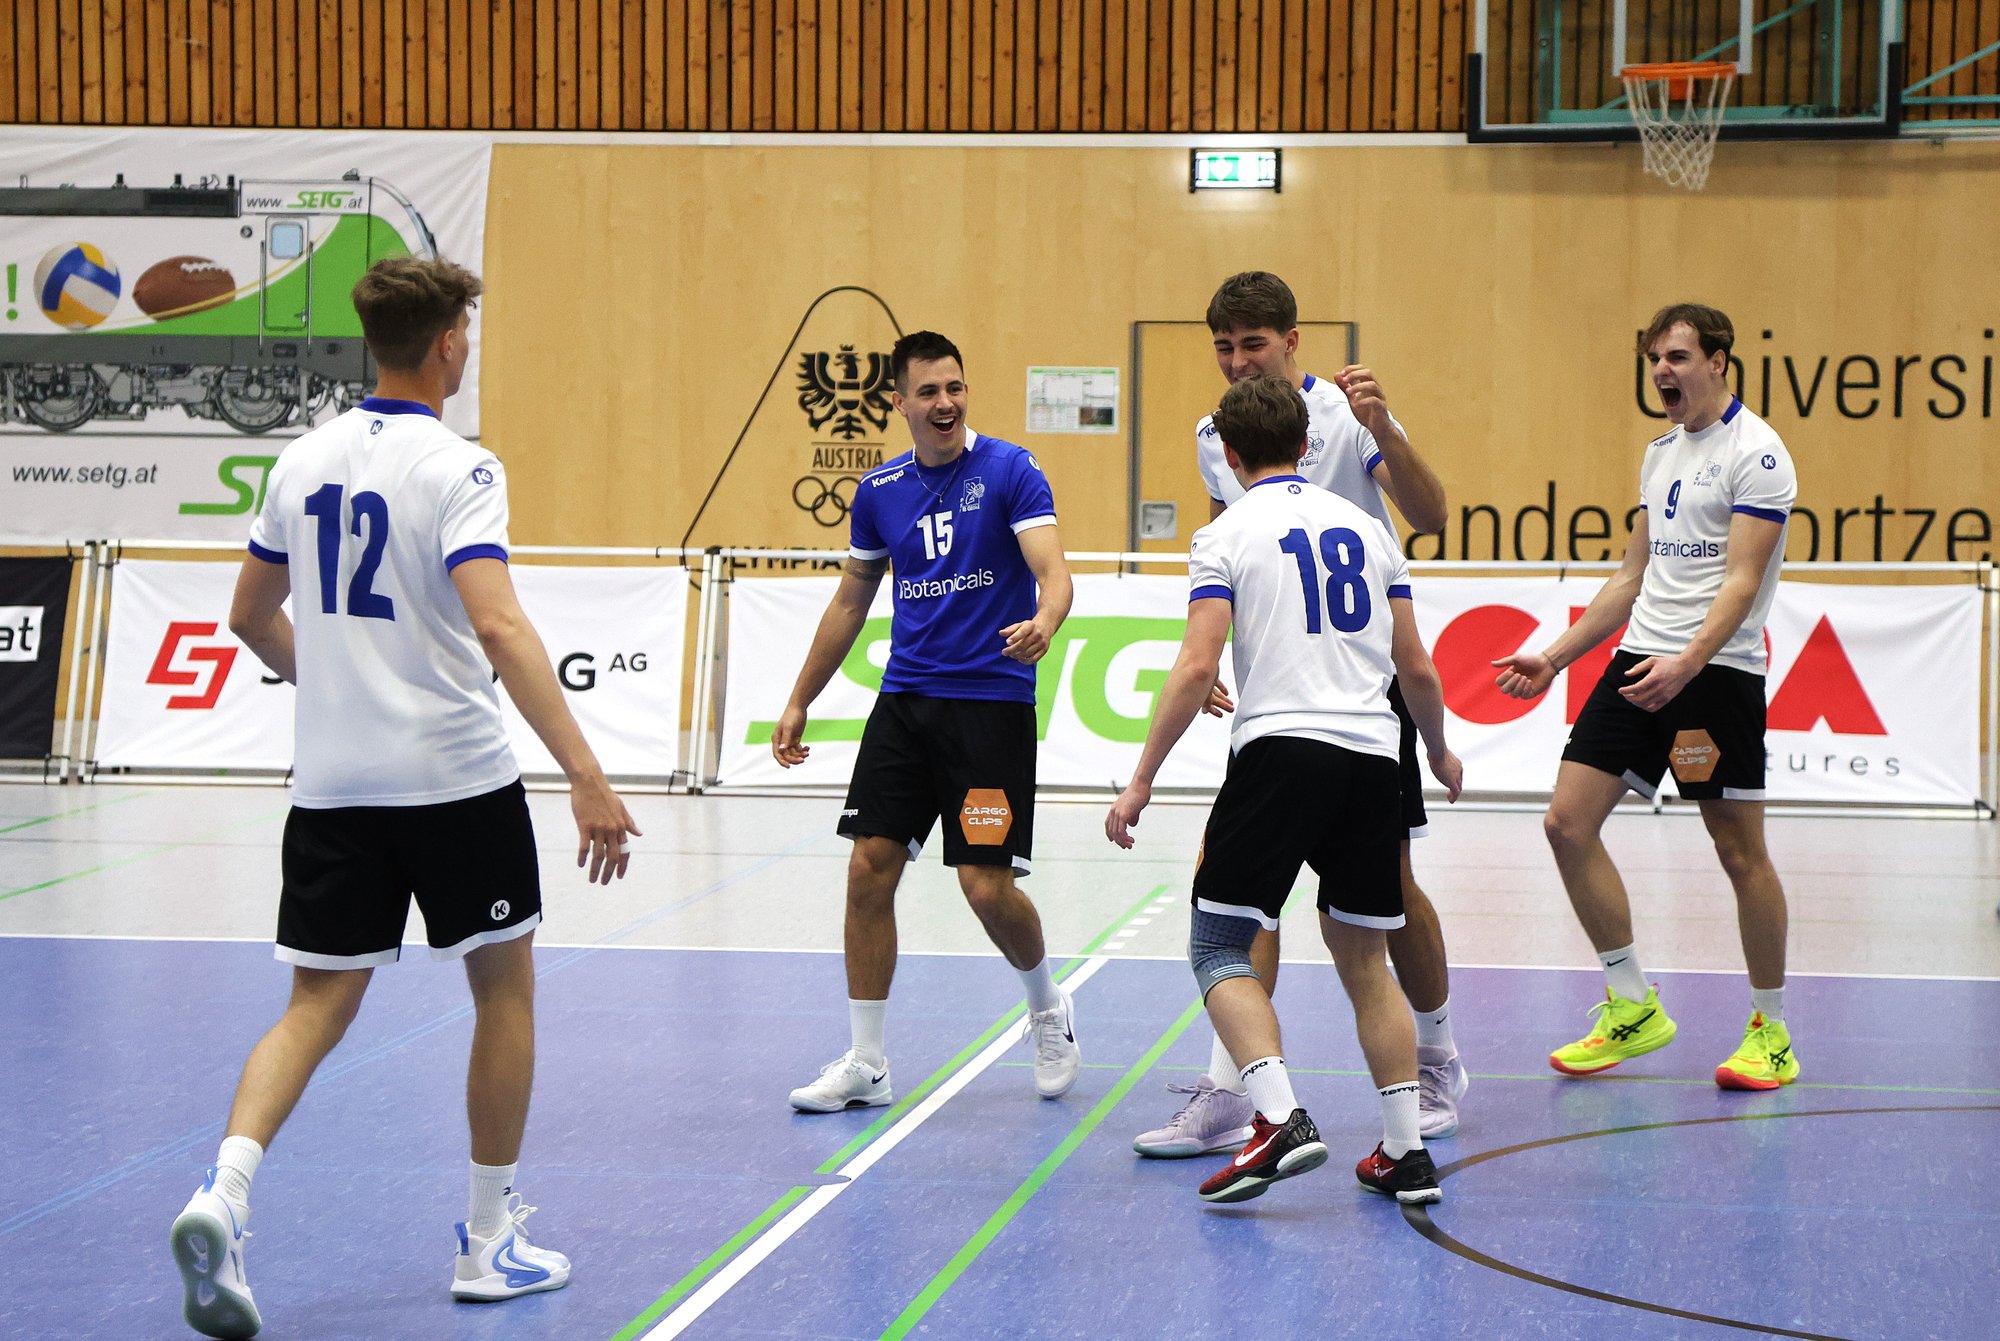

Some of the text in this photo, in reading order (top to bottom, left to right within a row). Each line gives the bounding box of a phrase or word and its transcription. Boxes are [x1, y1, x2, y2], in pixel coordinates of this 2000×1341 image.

[812, 447, 884, 469] AUSTRIA
[12, 463, 157, 489] www.setg.at
[871, 469, 905, 488] Kempa
[1664, 479, 1682, 519] 9
[916, 511, 954, 560] 15
[304, 483, 395, 621] 12
[1278, 527, 1372, 634] 18
[608, 653, 648, 673] AG
[1673, 746, 1713, 755] CARGO
[1765, 749, 1900, 776] tures
[964, 807, 1008, 816] CARGO
[968, 817, 1003, 826] CLIPS
